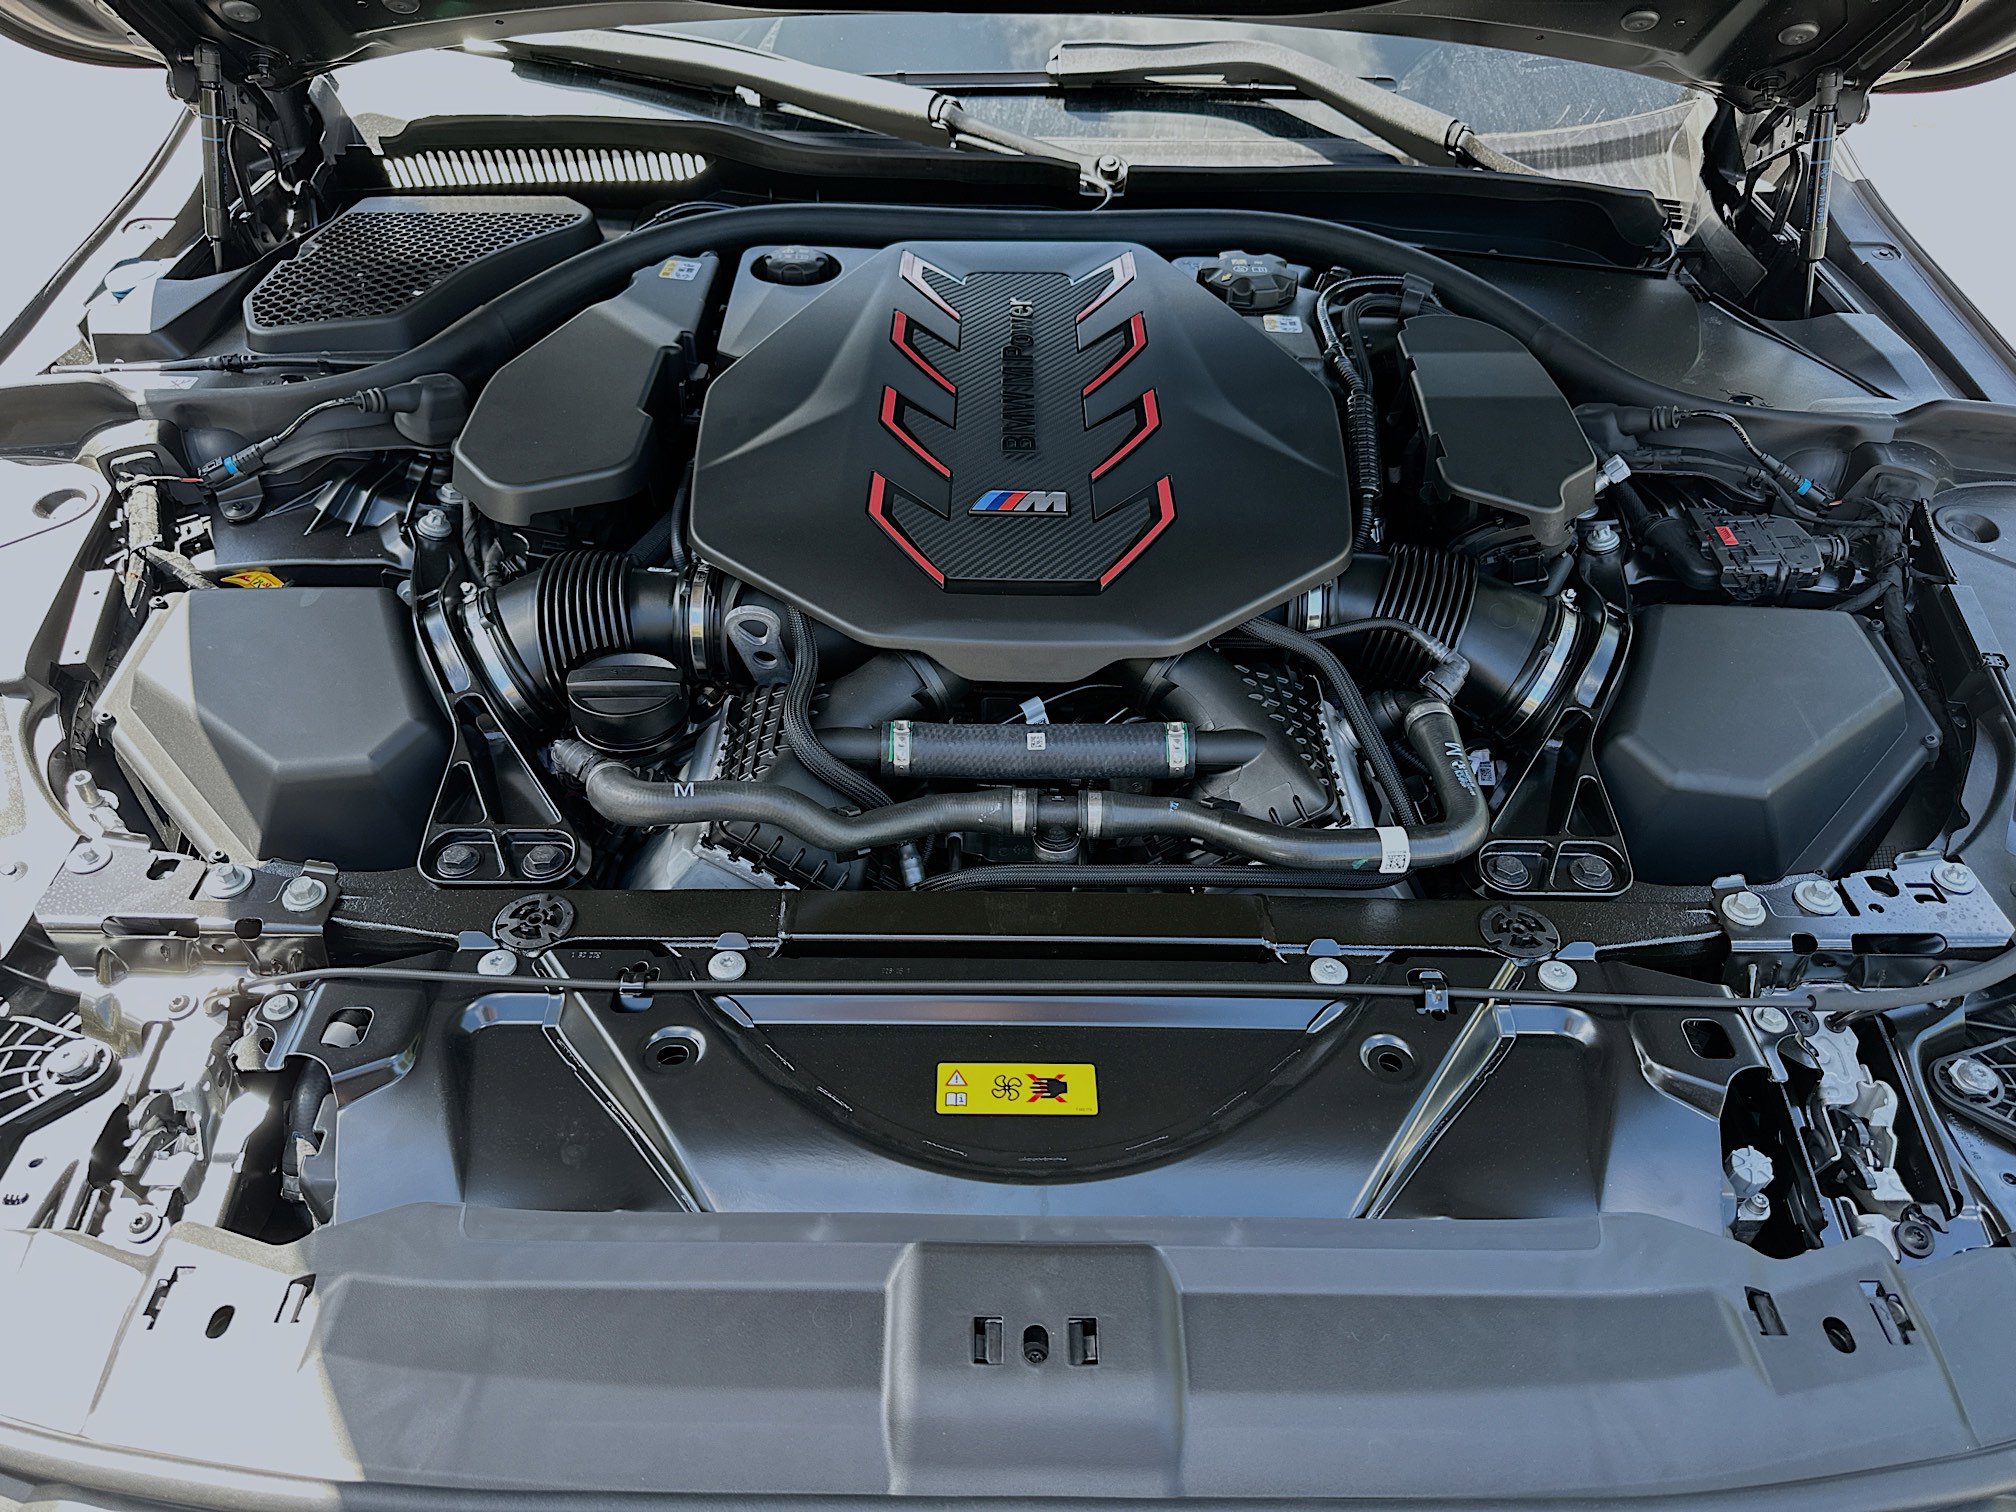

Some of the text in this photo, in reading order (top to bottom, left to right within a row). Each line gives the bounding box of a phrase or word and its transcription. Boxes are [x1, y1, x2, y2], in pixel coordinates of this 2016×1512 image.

[1001, 297, 1036, 452] BMW M Power
[1013, 490, 1067, 512] M
[673, 782, 695, 797] M
